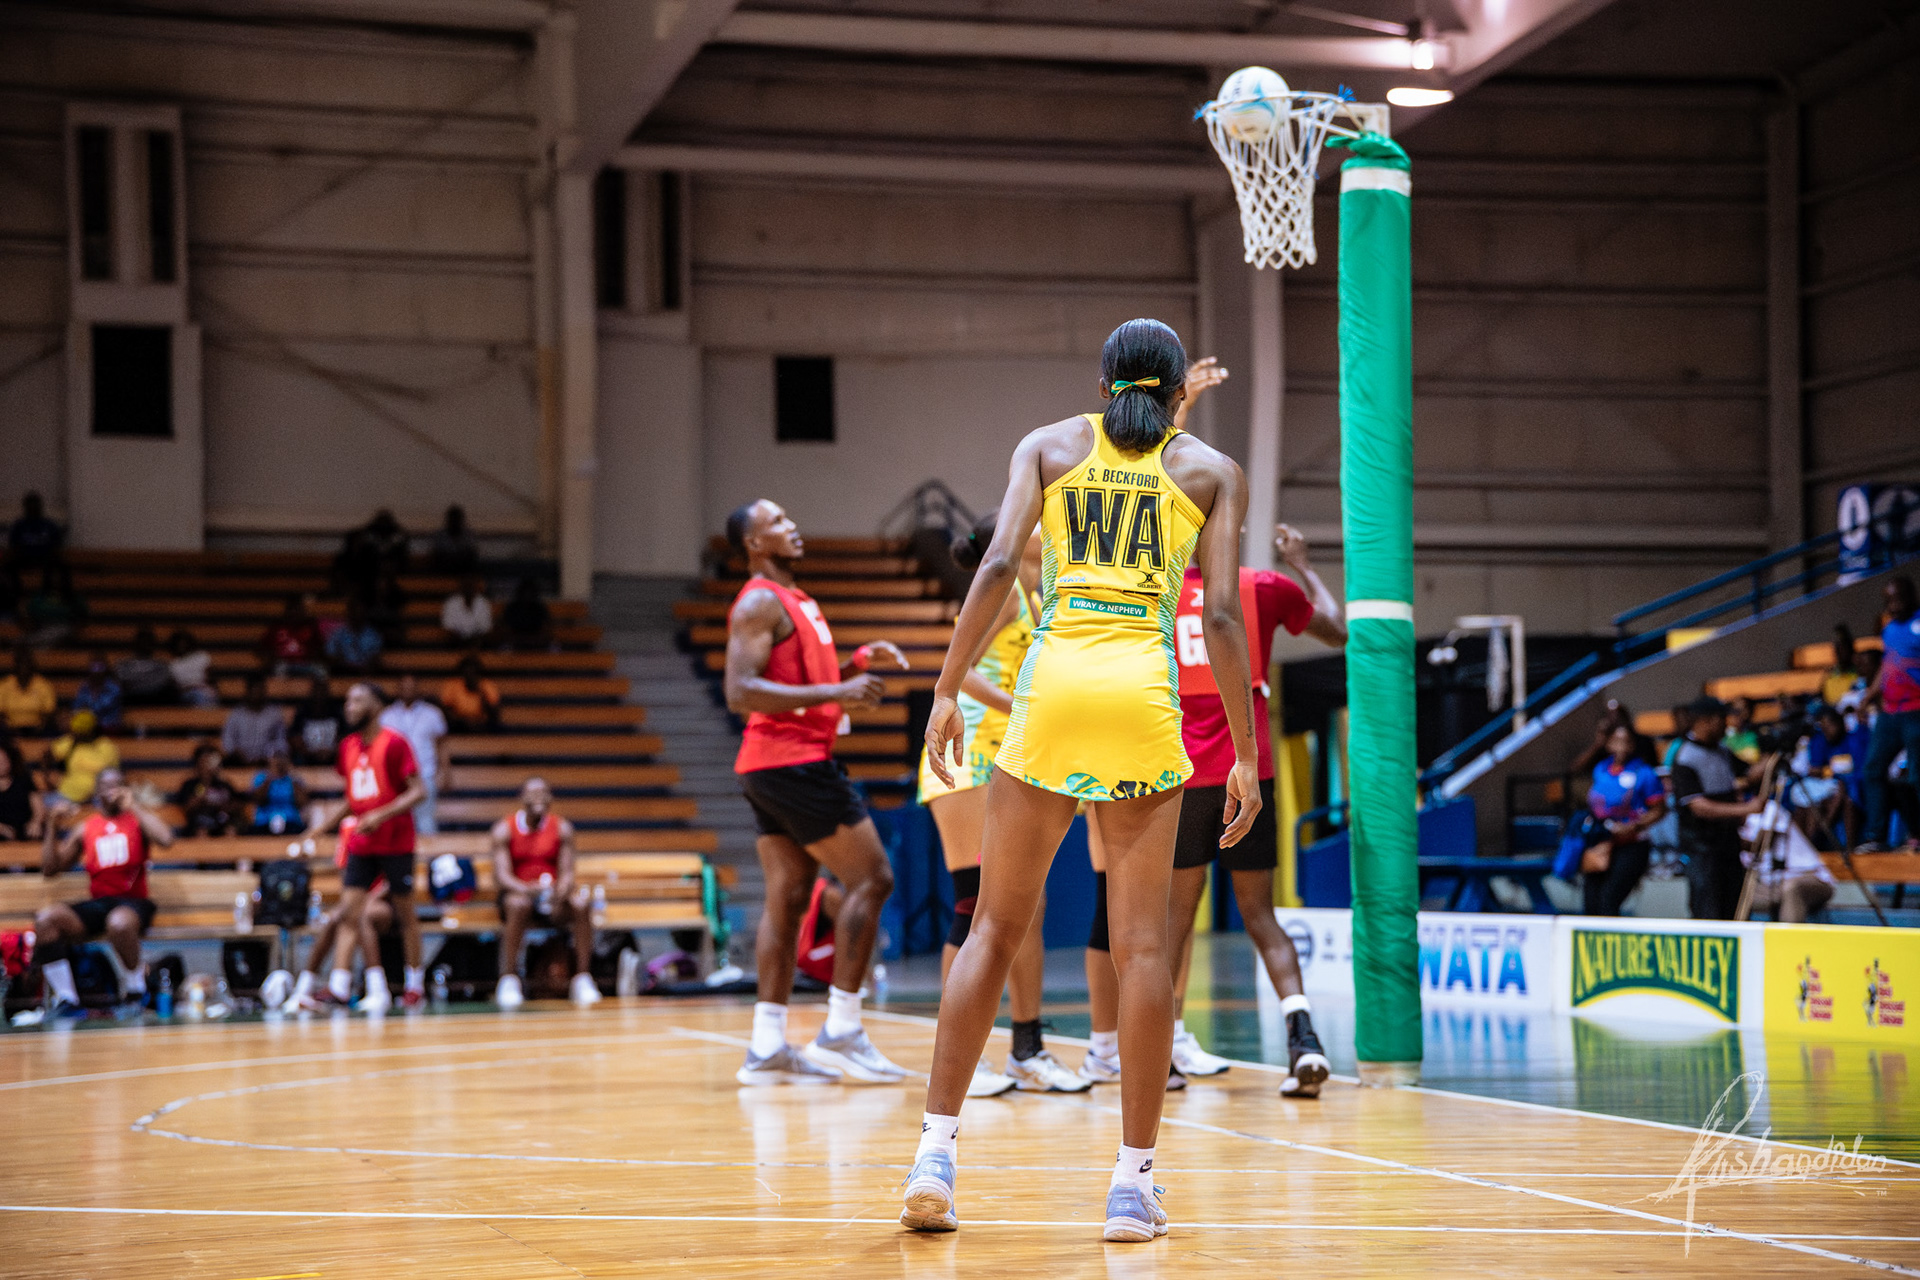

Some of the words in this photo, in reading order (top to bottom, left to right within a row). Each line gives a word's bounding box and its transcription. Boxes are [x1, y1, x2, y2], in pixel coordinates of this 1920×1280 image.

[1087, 467, 1098, 482] S.
[1102, 469, 1159, 489] BECKFORD
[1061, 486, 1165, 571] WA
[1072, 600, 1097, 610] WRAY
[1098, 603, 1106, 611] &
[1107, 604, 1143, 616] NEPHEW
[1576, 932, 1655, 999] NATURE
[1653, 935, 1734, 1012] VALLEY
